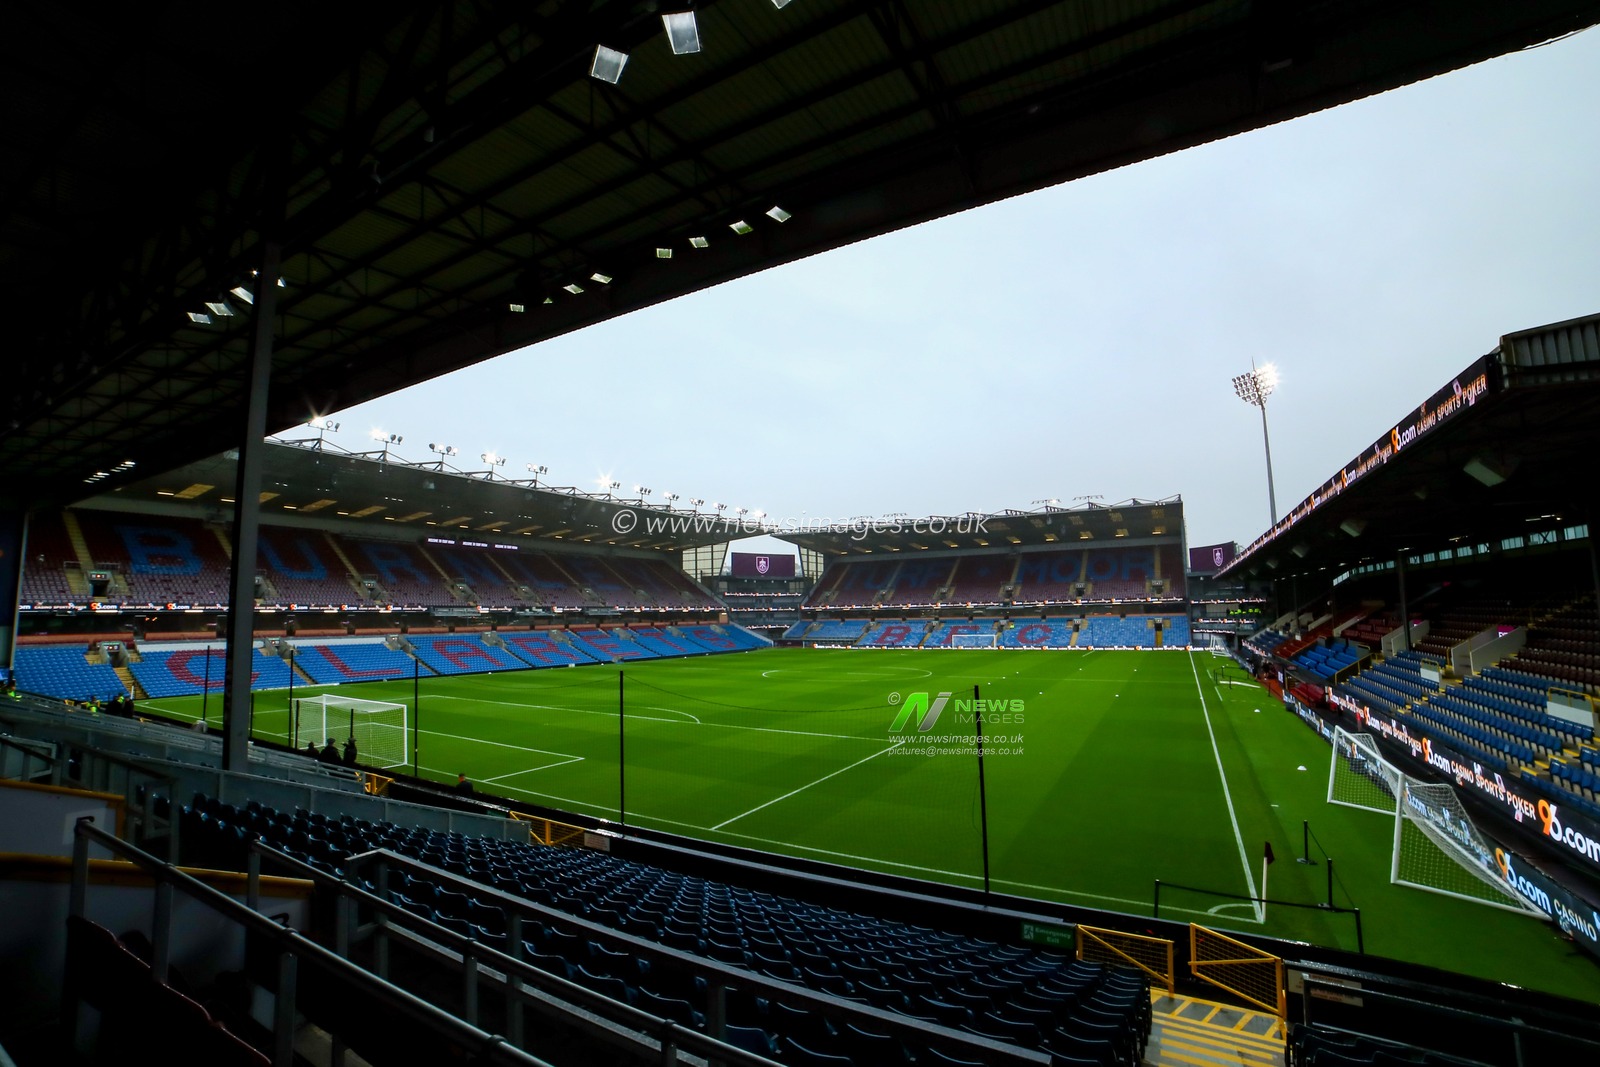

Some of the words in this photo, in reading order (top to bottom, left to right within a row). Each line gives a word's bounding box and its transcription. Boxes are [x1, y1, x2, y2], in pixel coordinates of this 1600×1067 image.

[1391, 425, 1417, 453] 96.com
[1417, 410, 1436, 436] CASINO
[1437, 395, 1461, 421] SPORTS
[1462, 374, 1487, 404] POKER
[1016, 551, 1155, 584] MOOR
[1421, 737, 1451, 775] 96.com
[1451, 760, 1474, 784] CASINO
[1475, 774, 1504, 801] SPORTS
[1506, 790, 1536, 820] POKER
[1537, 799, 1600, 863] 96.com
[1035, 927, 1072, 939] Emergency
[1495, 847, 1552, 914] 96.com
[1553, 898, 1597, 942] CASINO
